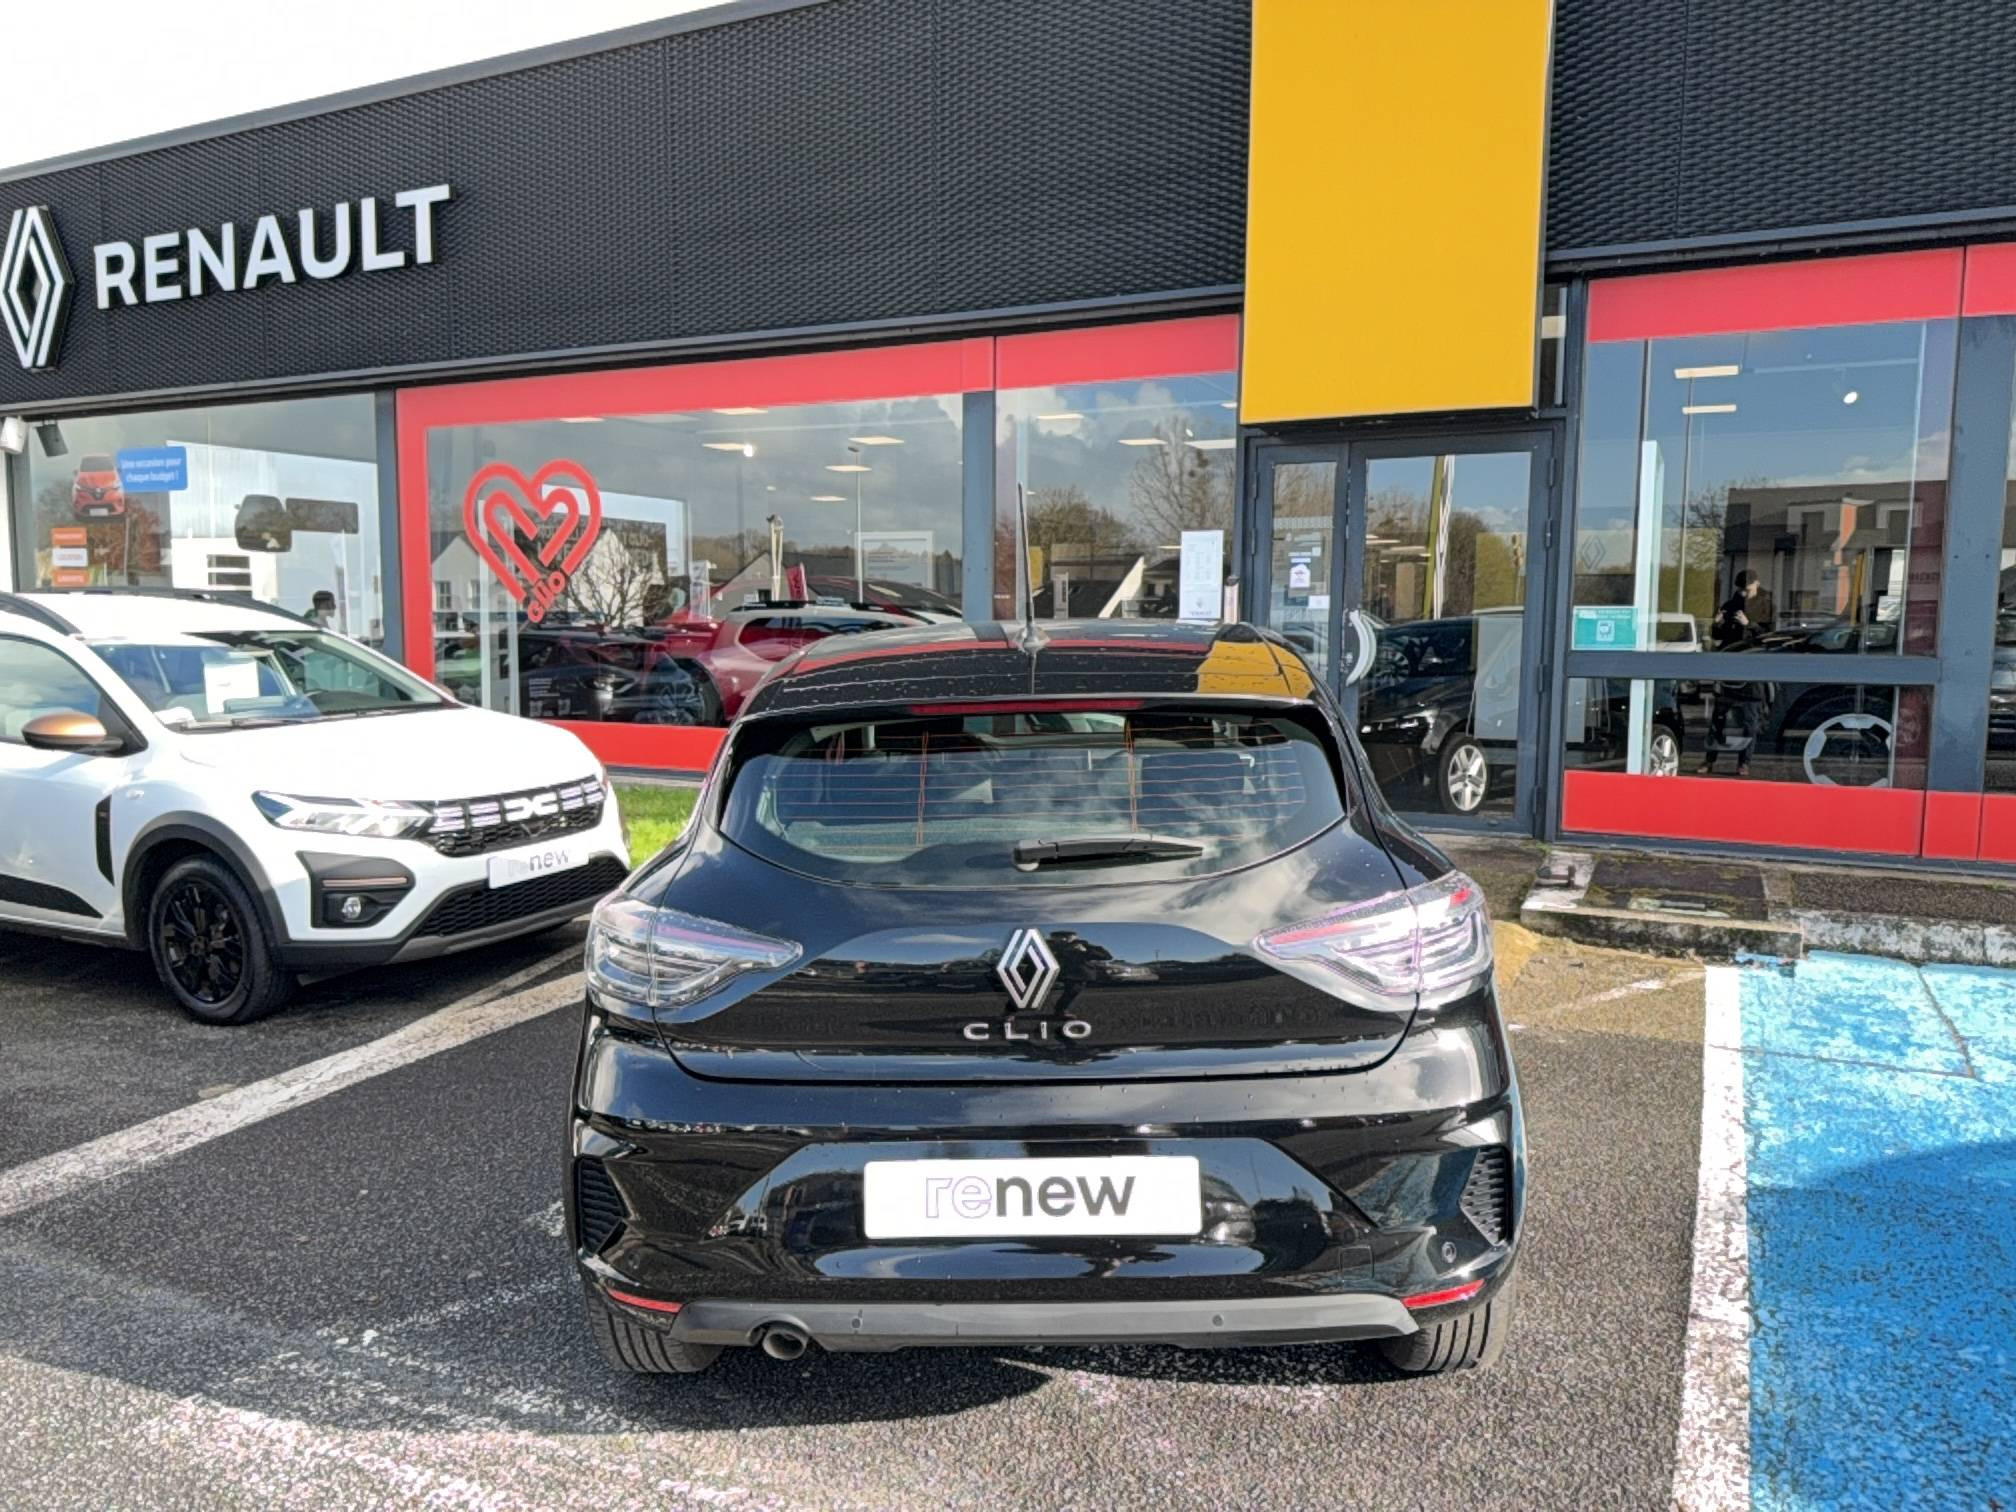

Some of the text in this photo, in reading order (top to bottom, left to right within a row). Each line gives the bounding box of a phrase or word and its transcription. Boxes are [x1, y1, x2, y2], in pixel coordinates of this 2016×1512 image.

[93, 182, 451, 311] RENAULT
[962, 1019, 1092, 1041] CLIO
[925, 1175, 1137, 1219] renew
